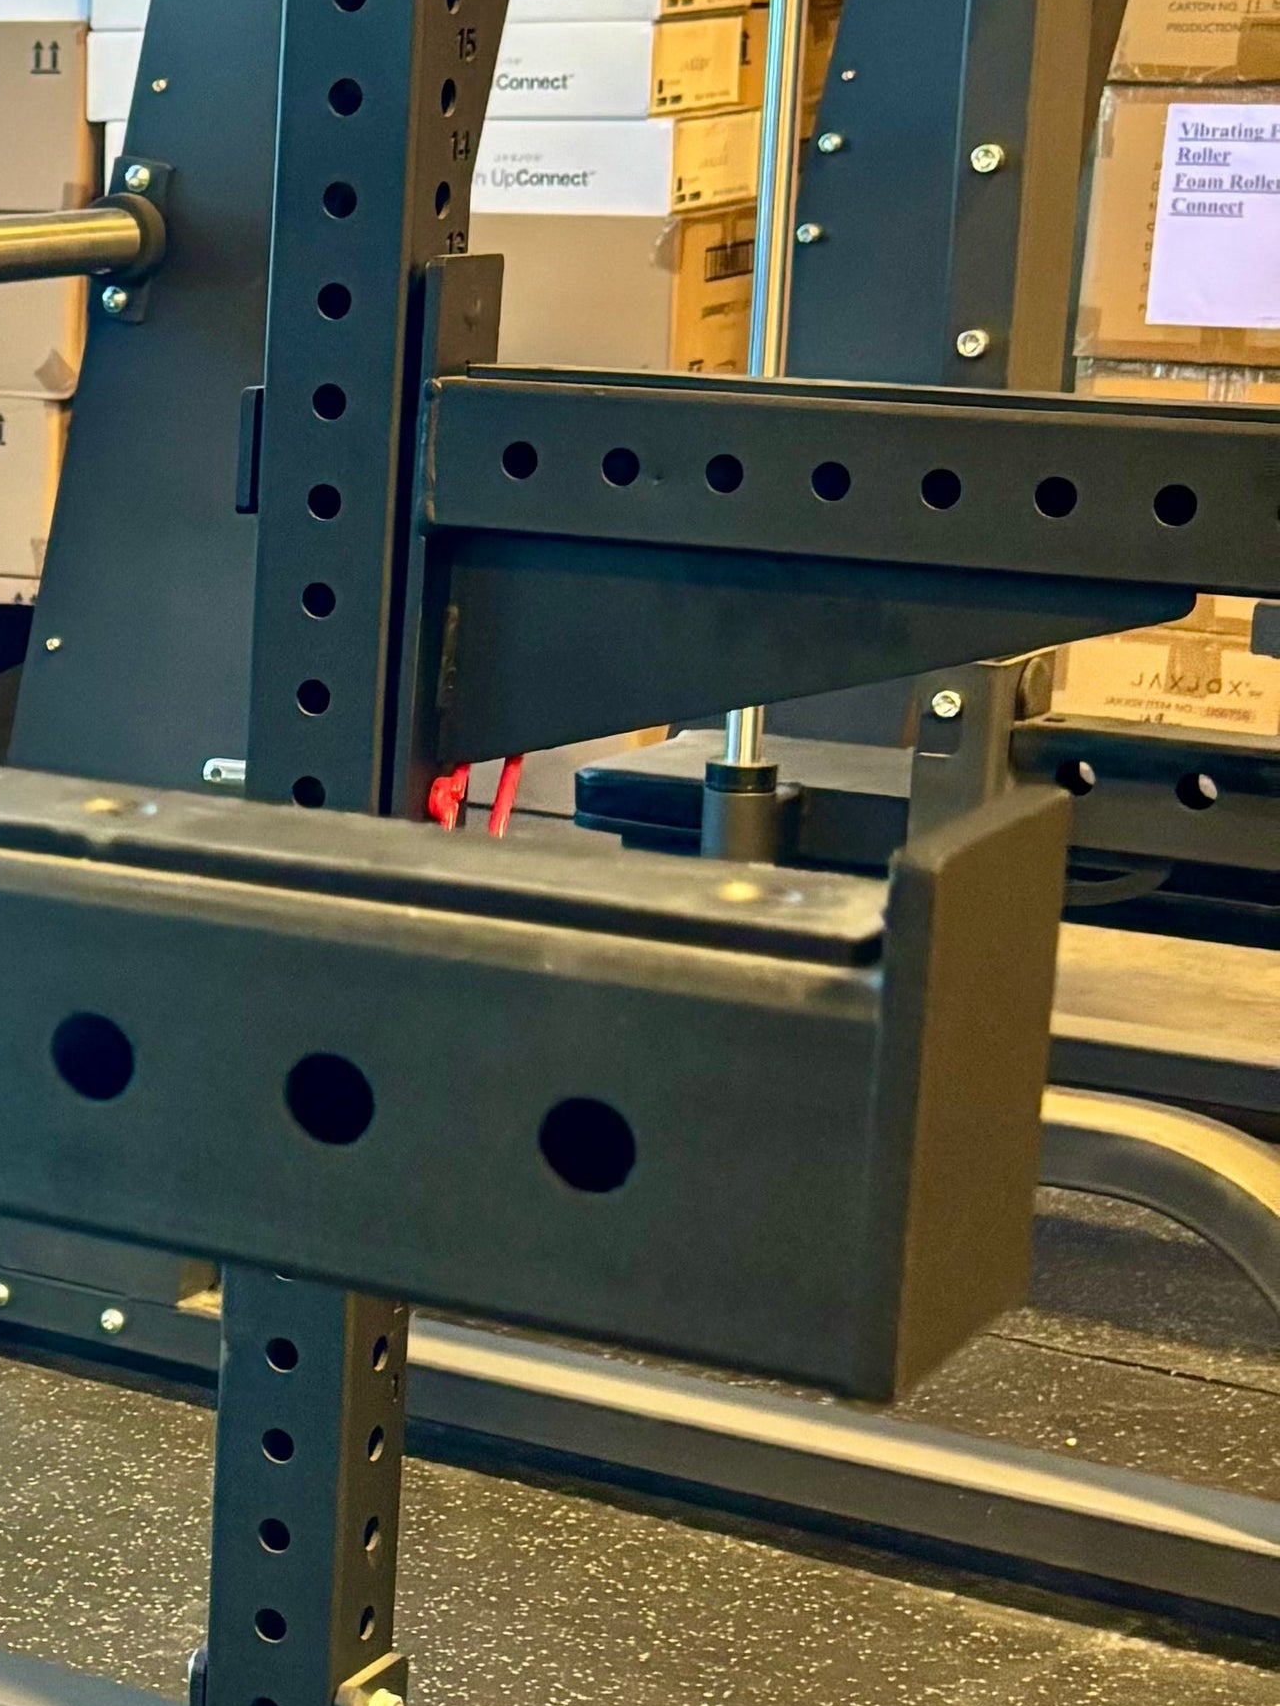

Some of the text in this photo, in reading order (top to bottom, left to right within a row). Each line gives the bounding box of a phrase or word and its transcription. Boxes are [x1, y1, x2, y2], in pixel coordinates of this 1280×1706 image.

[457, 27, 478, 63] 15
[496, 73, 569, 91] Connect
[1180, 122, 1264, 141] Vibrating
[450, 131, 471, 162] 14
[1177, 147, 1232, 164] Roller
[1174, 173, 1223, 189] Foam
[1171, 197, 1244, 215] Connect
